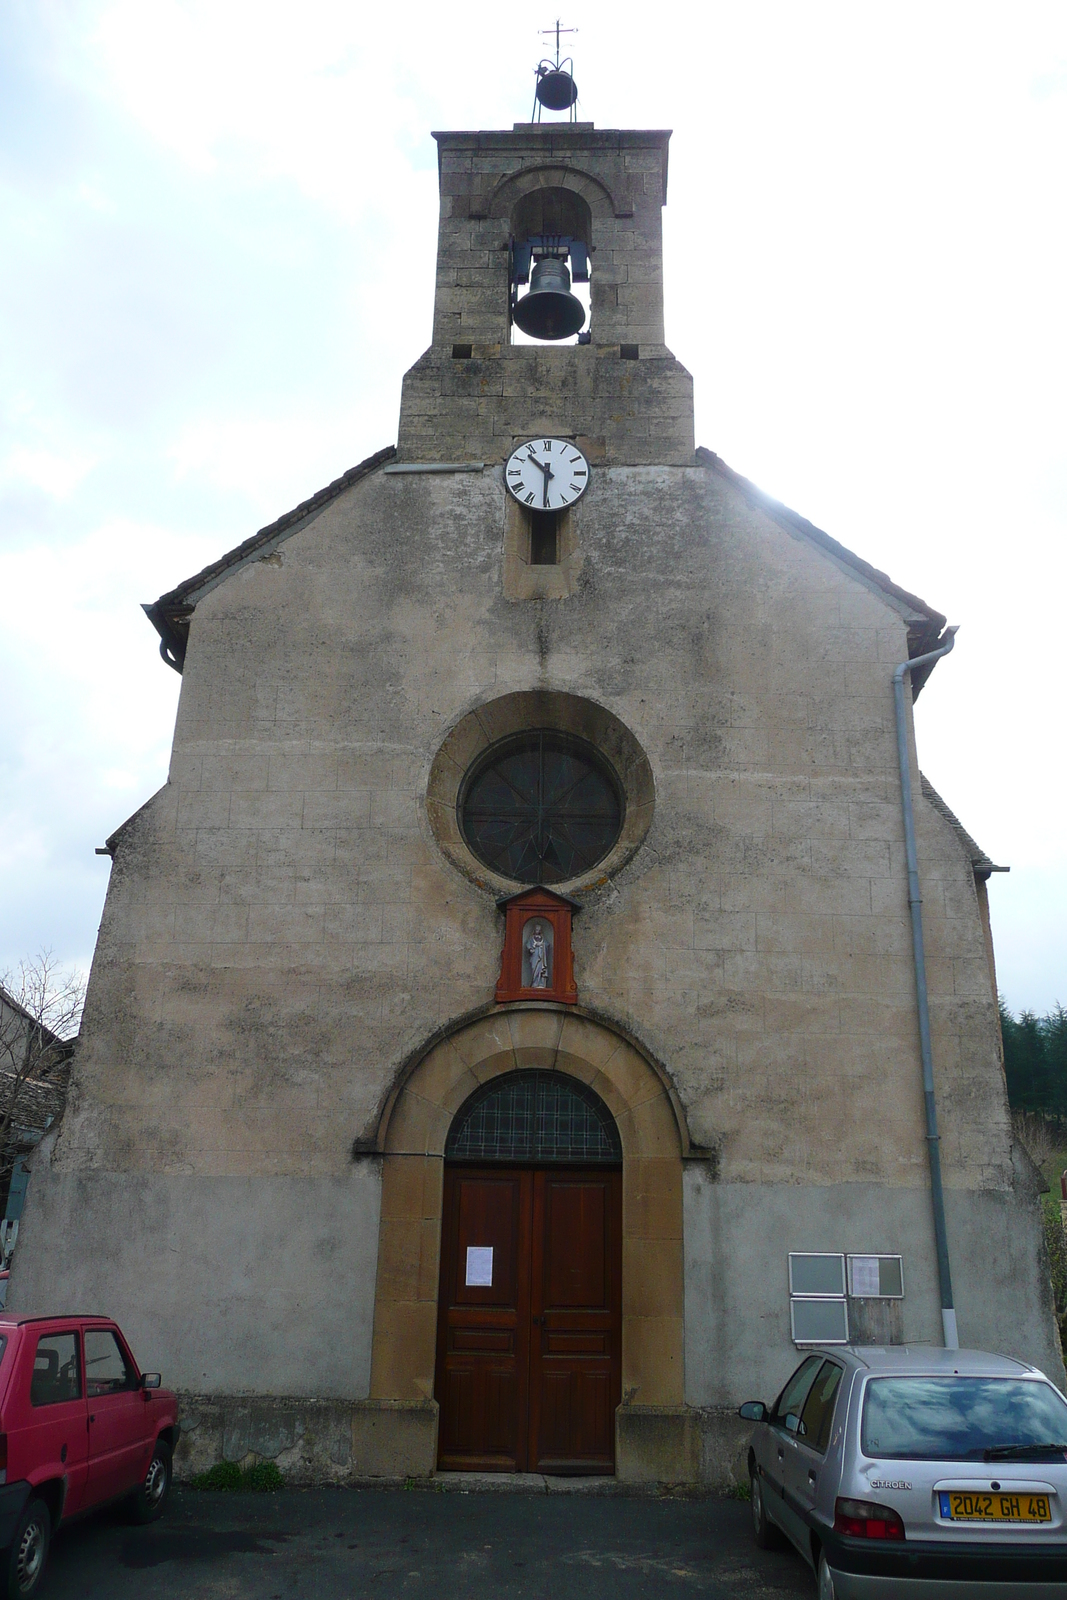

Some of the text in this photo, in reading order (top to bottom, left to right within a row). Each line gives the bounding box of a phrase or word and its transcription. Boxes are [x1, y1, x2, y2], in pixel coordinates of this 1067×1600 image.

[544, 441, 552, 451] XII
[513, 455, 525, 463] X
[560, 493, 568, 504] V
[953, 1496, 993, 1516] 2042
[1000, 1497, 1020, 1516] GH
[1028, 1498, 1047, 1517] 48
